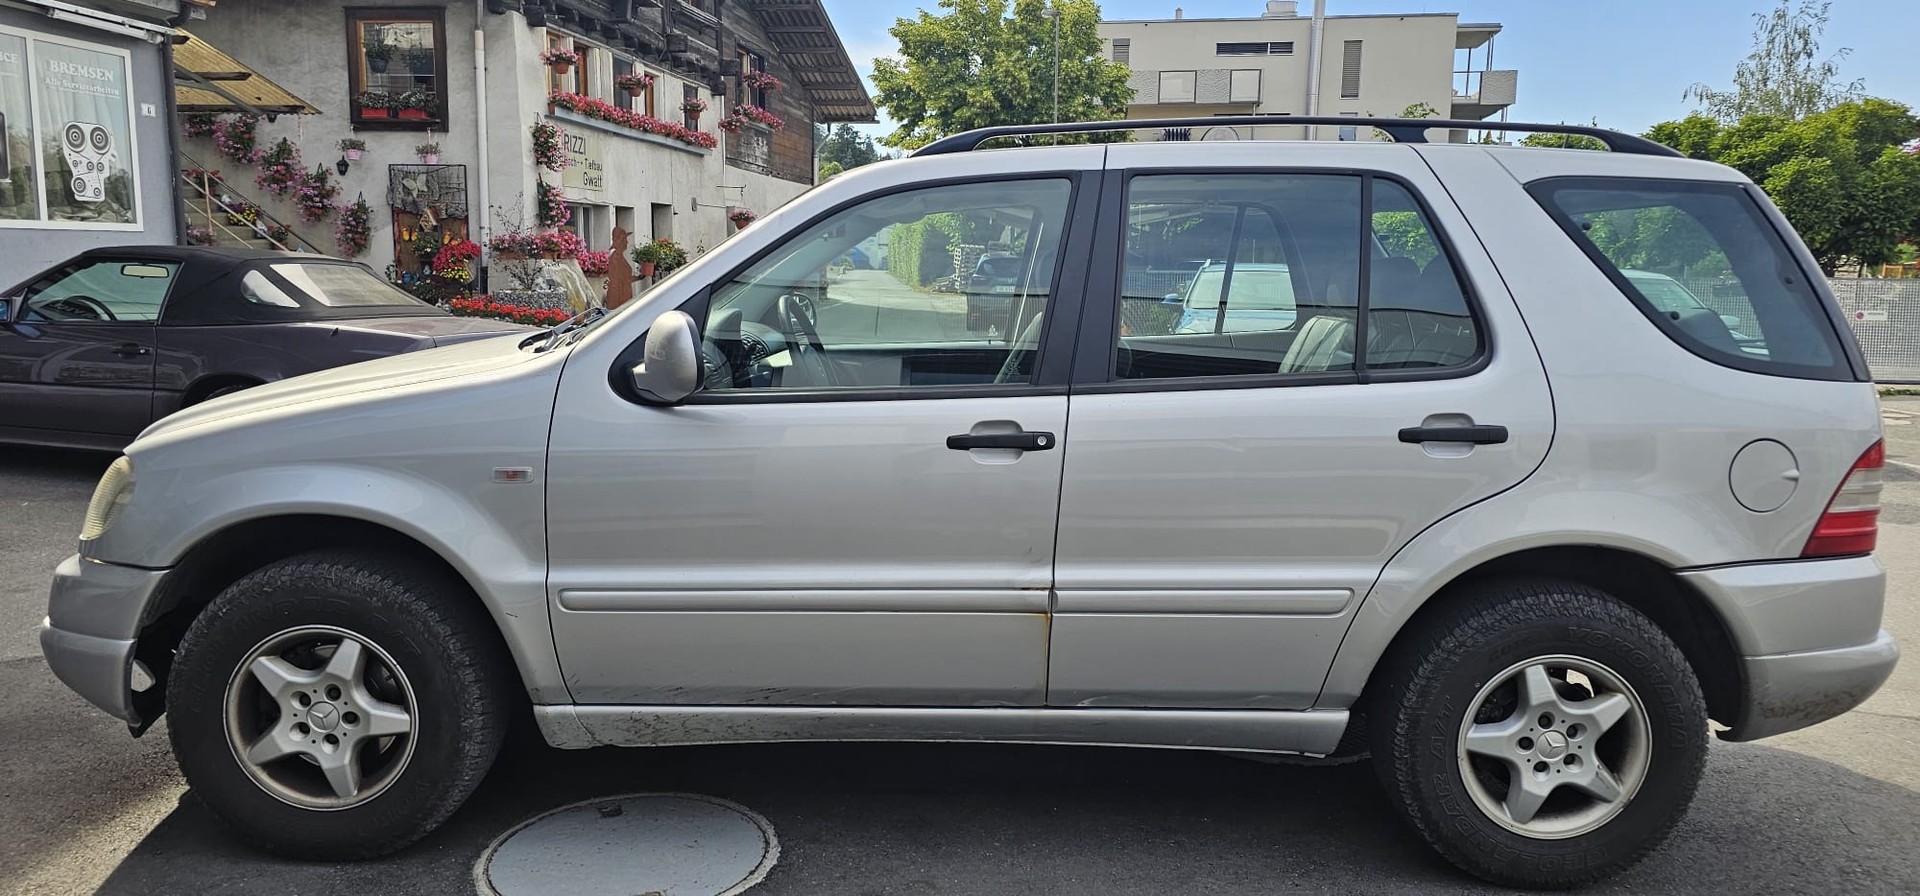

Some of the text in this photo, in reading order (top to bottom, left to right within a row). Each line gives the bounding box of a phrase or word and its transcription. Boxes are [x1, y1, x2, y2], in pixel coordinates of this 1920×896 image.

[50, 60, 114, 82] BREMSEN
[45, 77, 60, 87] Alle
[564, 133, 586, 155] RIZZI
[584, 158, 603, 171] Tiefbau
[583, 171, 603, 188] Gwatt
